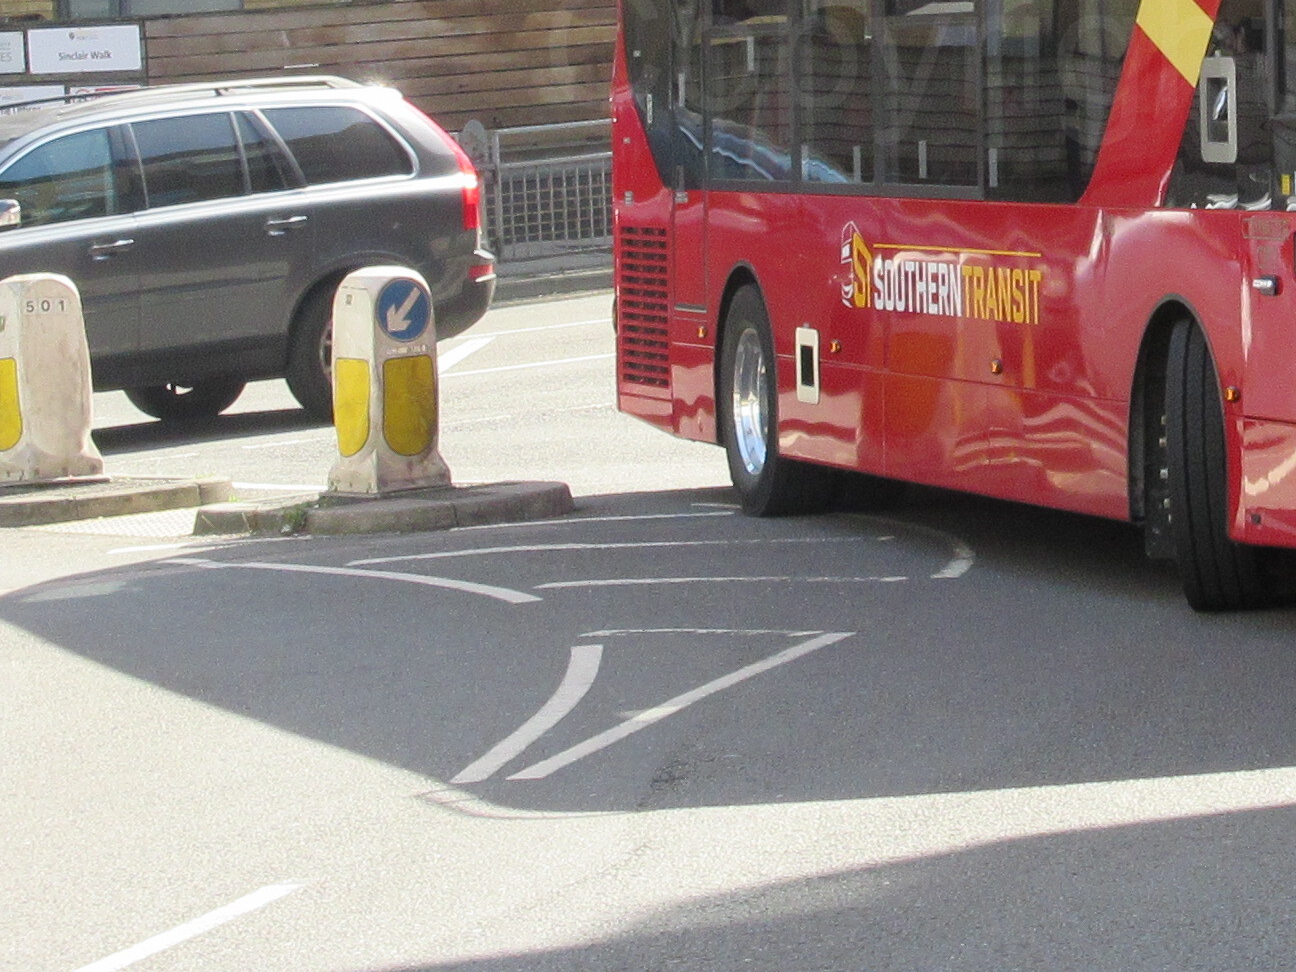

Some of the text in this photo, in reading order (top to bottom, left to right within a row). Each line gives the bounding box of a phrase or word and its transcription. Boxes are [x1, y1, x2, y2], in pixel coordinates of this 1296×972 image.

[58, 50, 112, 61] Sinclair Walk
[873, 255, 962, 317] SOUTHERN
[962, 265, 1041, 325] TRANSIT
[26, 299, 65, 313] 501
